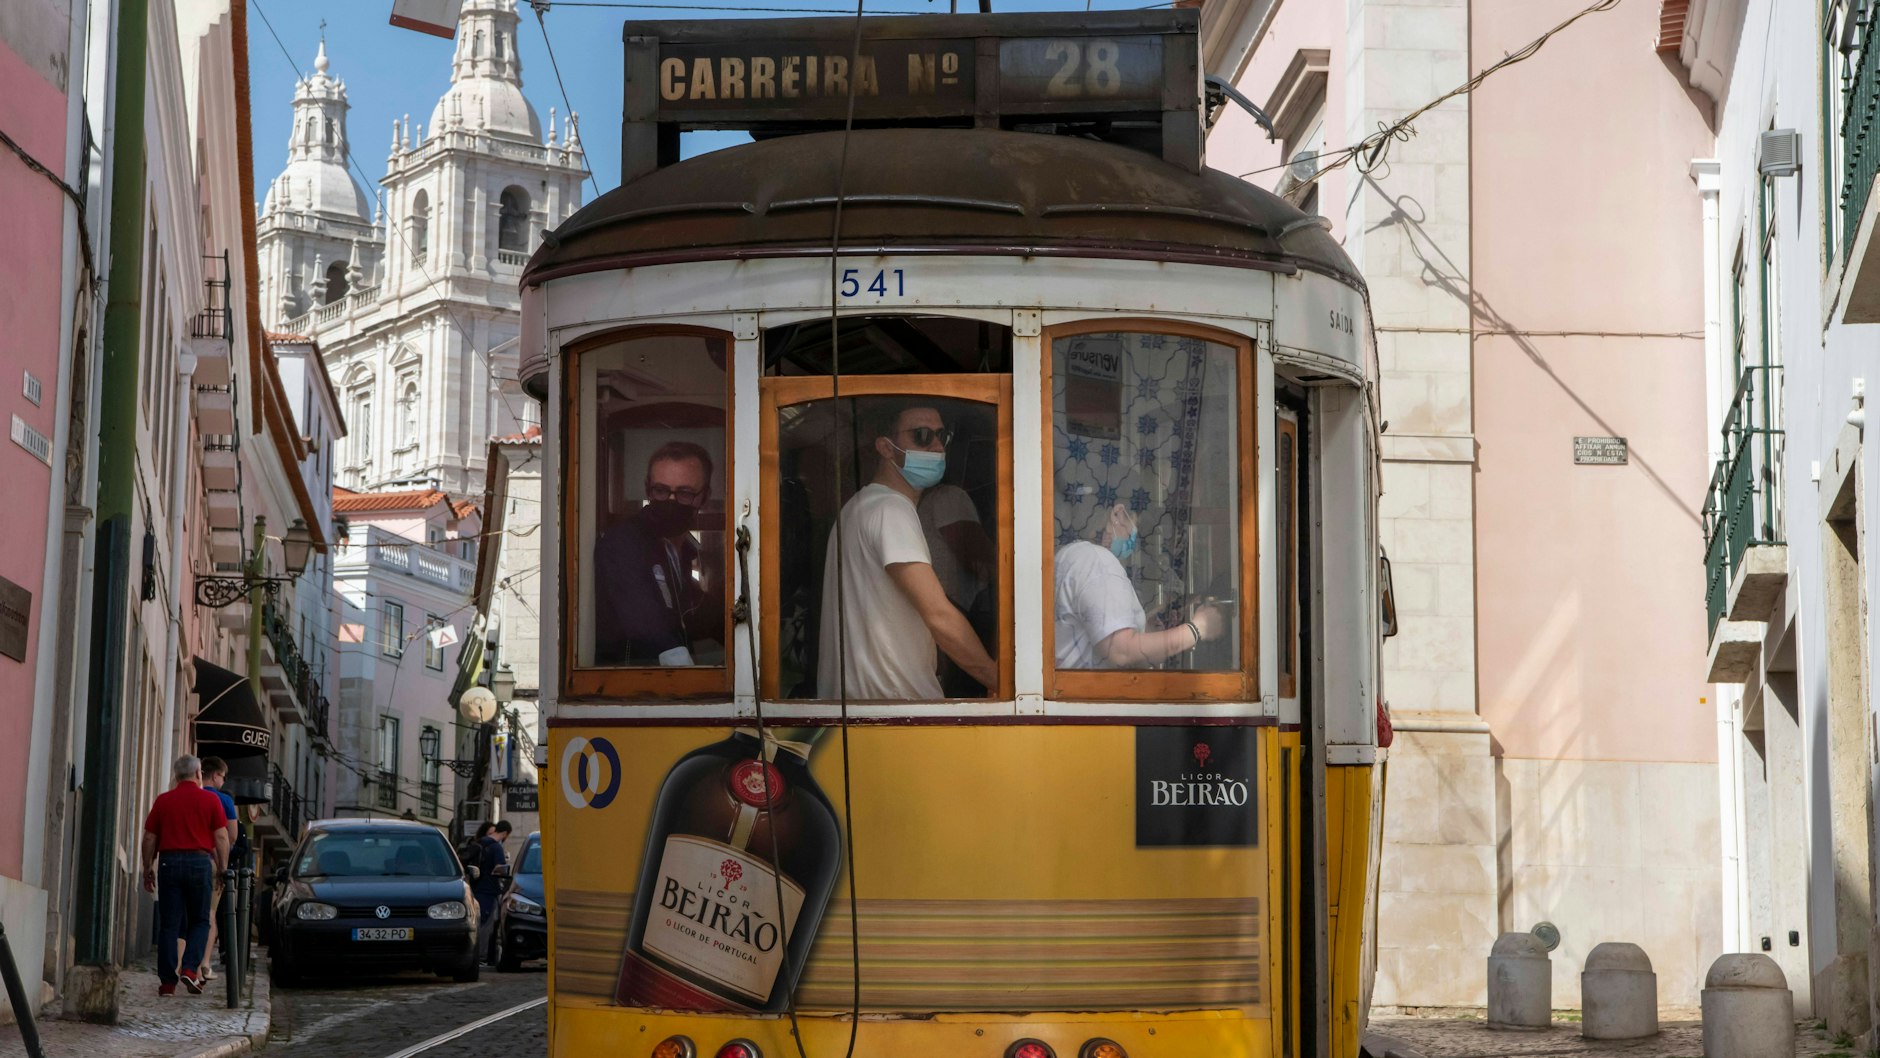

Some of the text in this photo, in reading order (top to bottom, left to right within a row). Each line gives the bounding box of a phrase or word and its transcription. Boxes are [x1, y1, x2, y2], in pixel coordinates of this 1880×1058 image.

[660, 56, 878, 100] CARREIRA
[1046, 40, 1120, 97] 28
[841, 269, 904, 297] 541
[1150, 778, 1248, 806] BEIRÃO
[697, 881, 751, 909] LICOR
[659, 876, 779, 952] BEIRÃO
[673, 922, 697, 938] LICOR
[699, 934, 710, 944] DE
[713, 939, 758, 965] PORTUGAL
